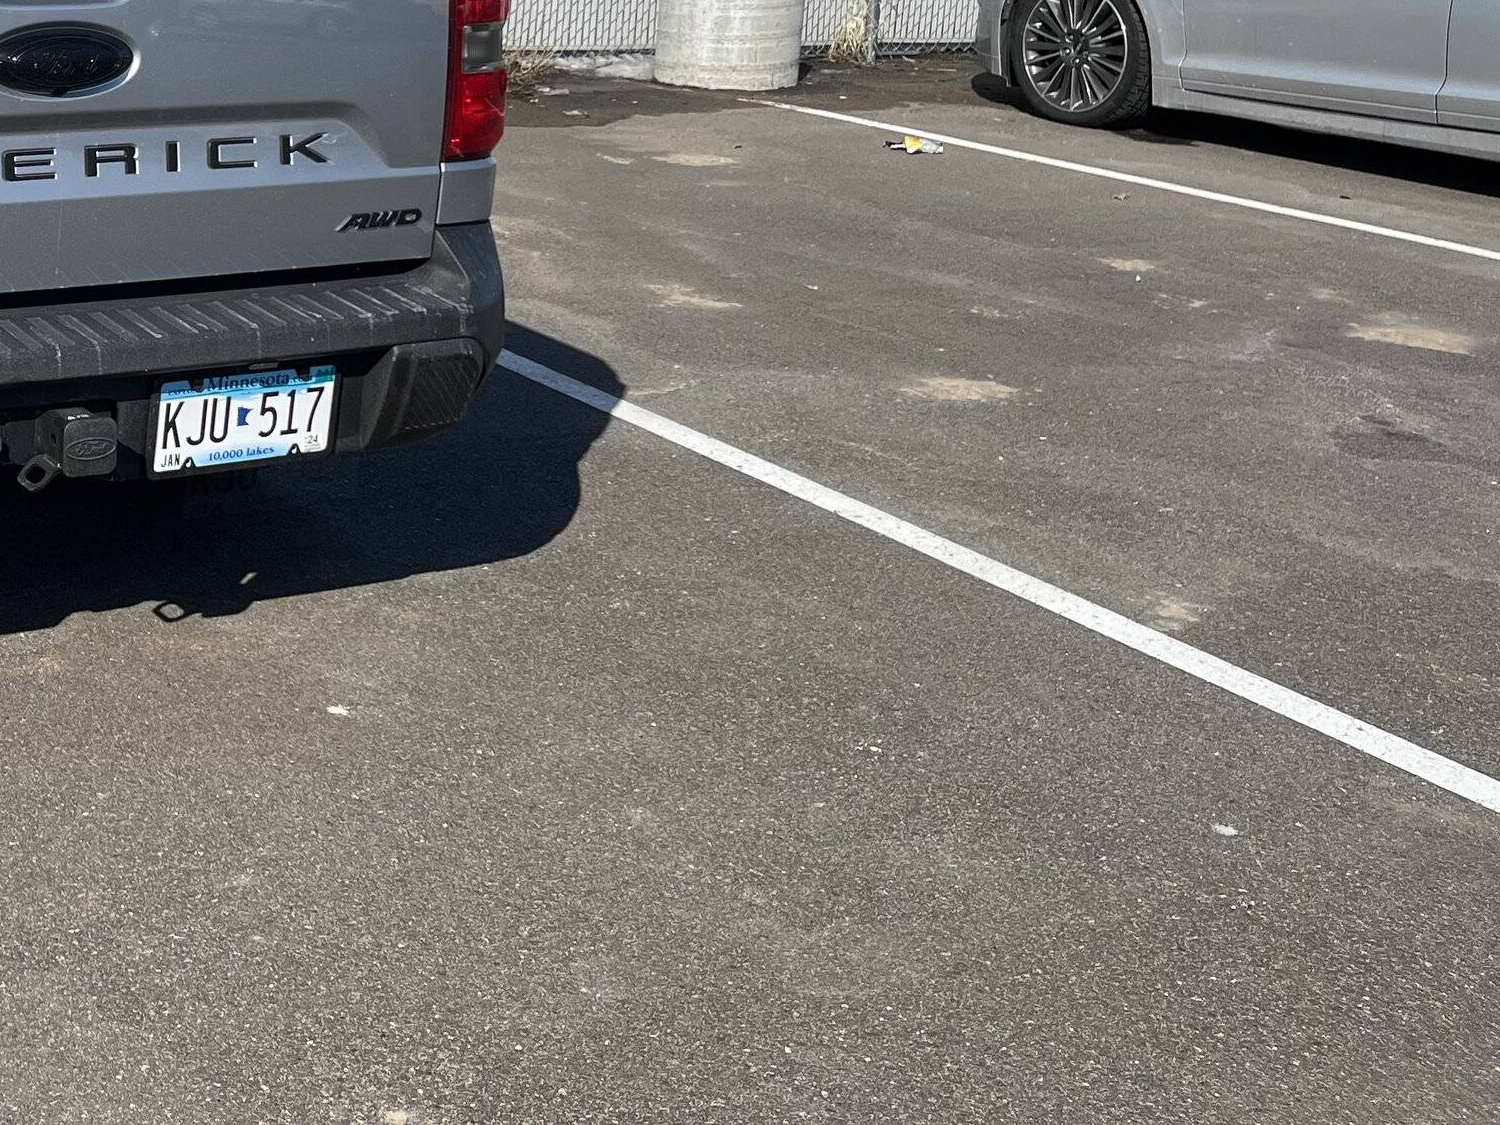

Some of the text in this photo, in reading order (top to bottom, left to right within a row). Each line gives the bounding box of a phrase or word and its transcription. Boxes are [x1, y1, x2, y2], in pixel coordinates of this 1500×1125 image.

[334, 208, 422, 232] AWD
[207, 372, 290, 392] Minnesota
[162, 386, 325, 450] KJU 517
[161, 453, 180, 468] JAN
[247, 446, 275, 457] lakes
